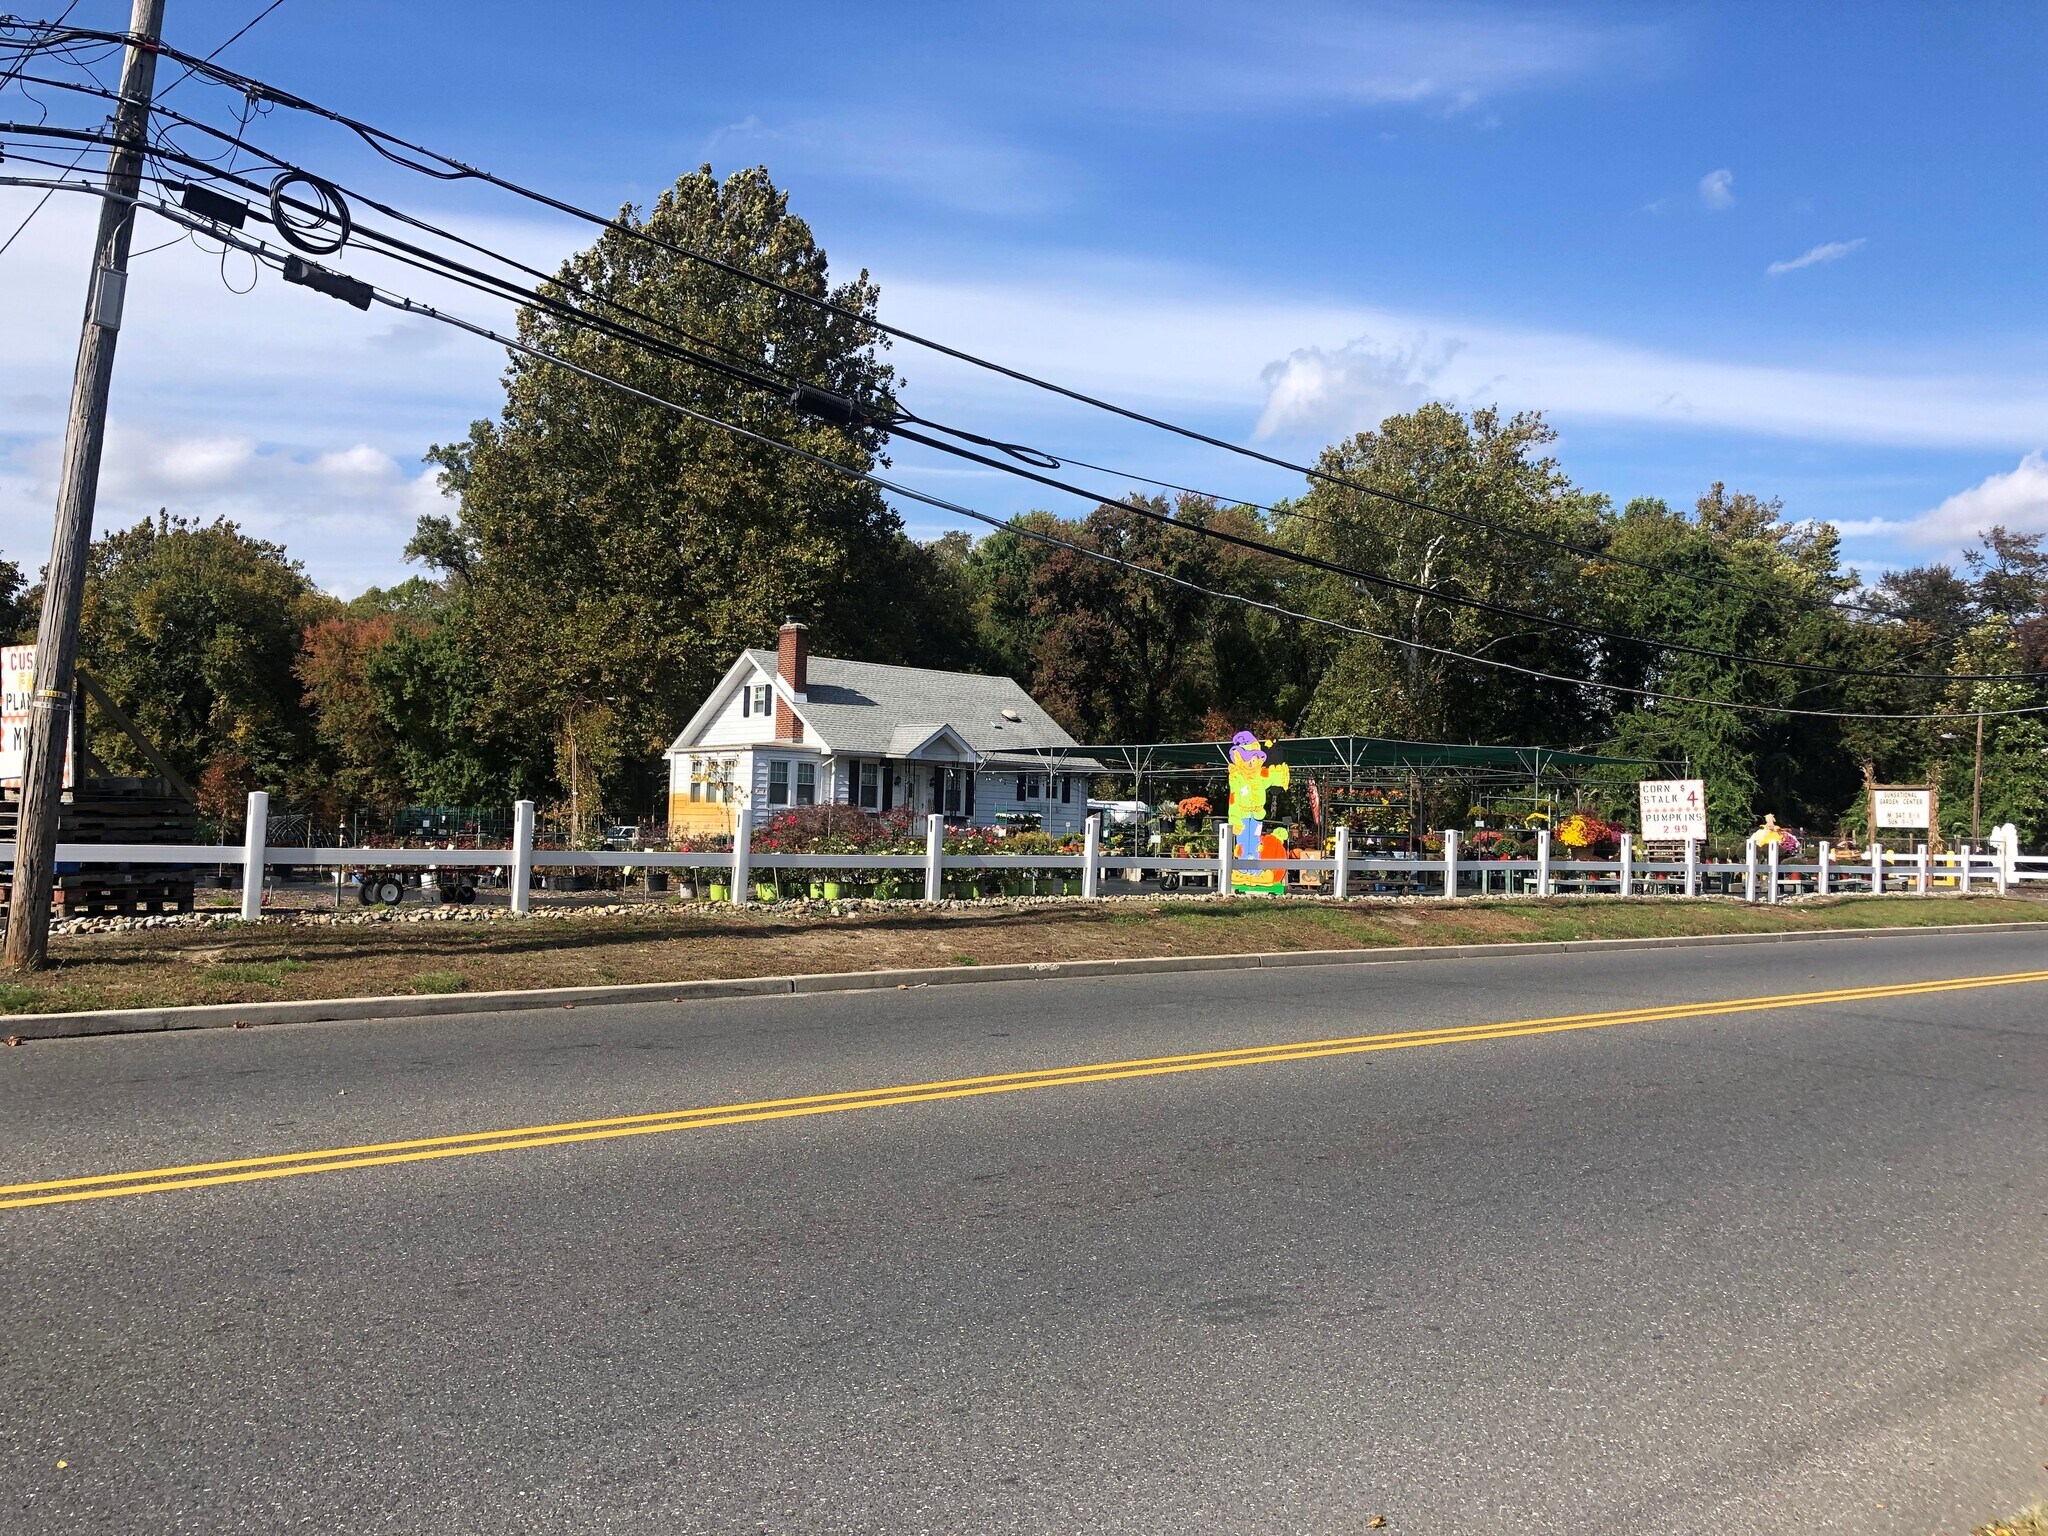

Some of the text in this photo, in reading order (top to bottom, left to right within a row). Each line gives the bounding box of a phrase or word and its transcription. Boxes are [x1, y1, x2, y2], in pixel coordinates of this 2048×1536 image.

[10, 652, 33, 671] CUS
[6, 693, 31, 711] PLAN
[1643, 785, 1670, 793] CORN
[1643, 795, 1678, 804] STALK
[1645, 814, 1702, 822] PUMPKINS
[1663, 825, 1688, 834] 2.99
